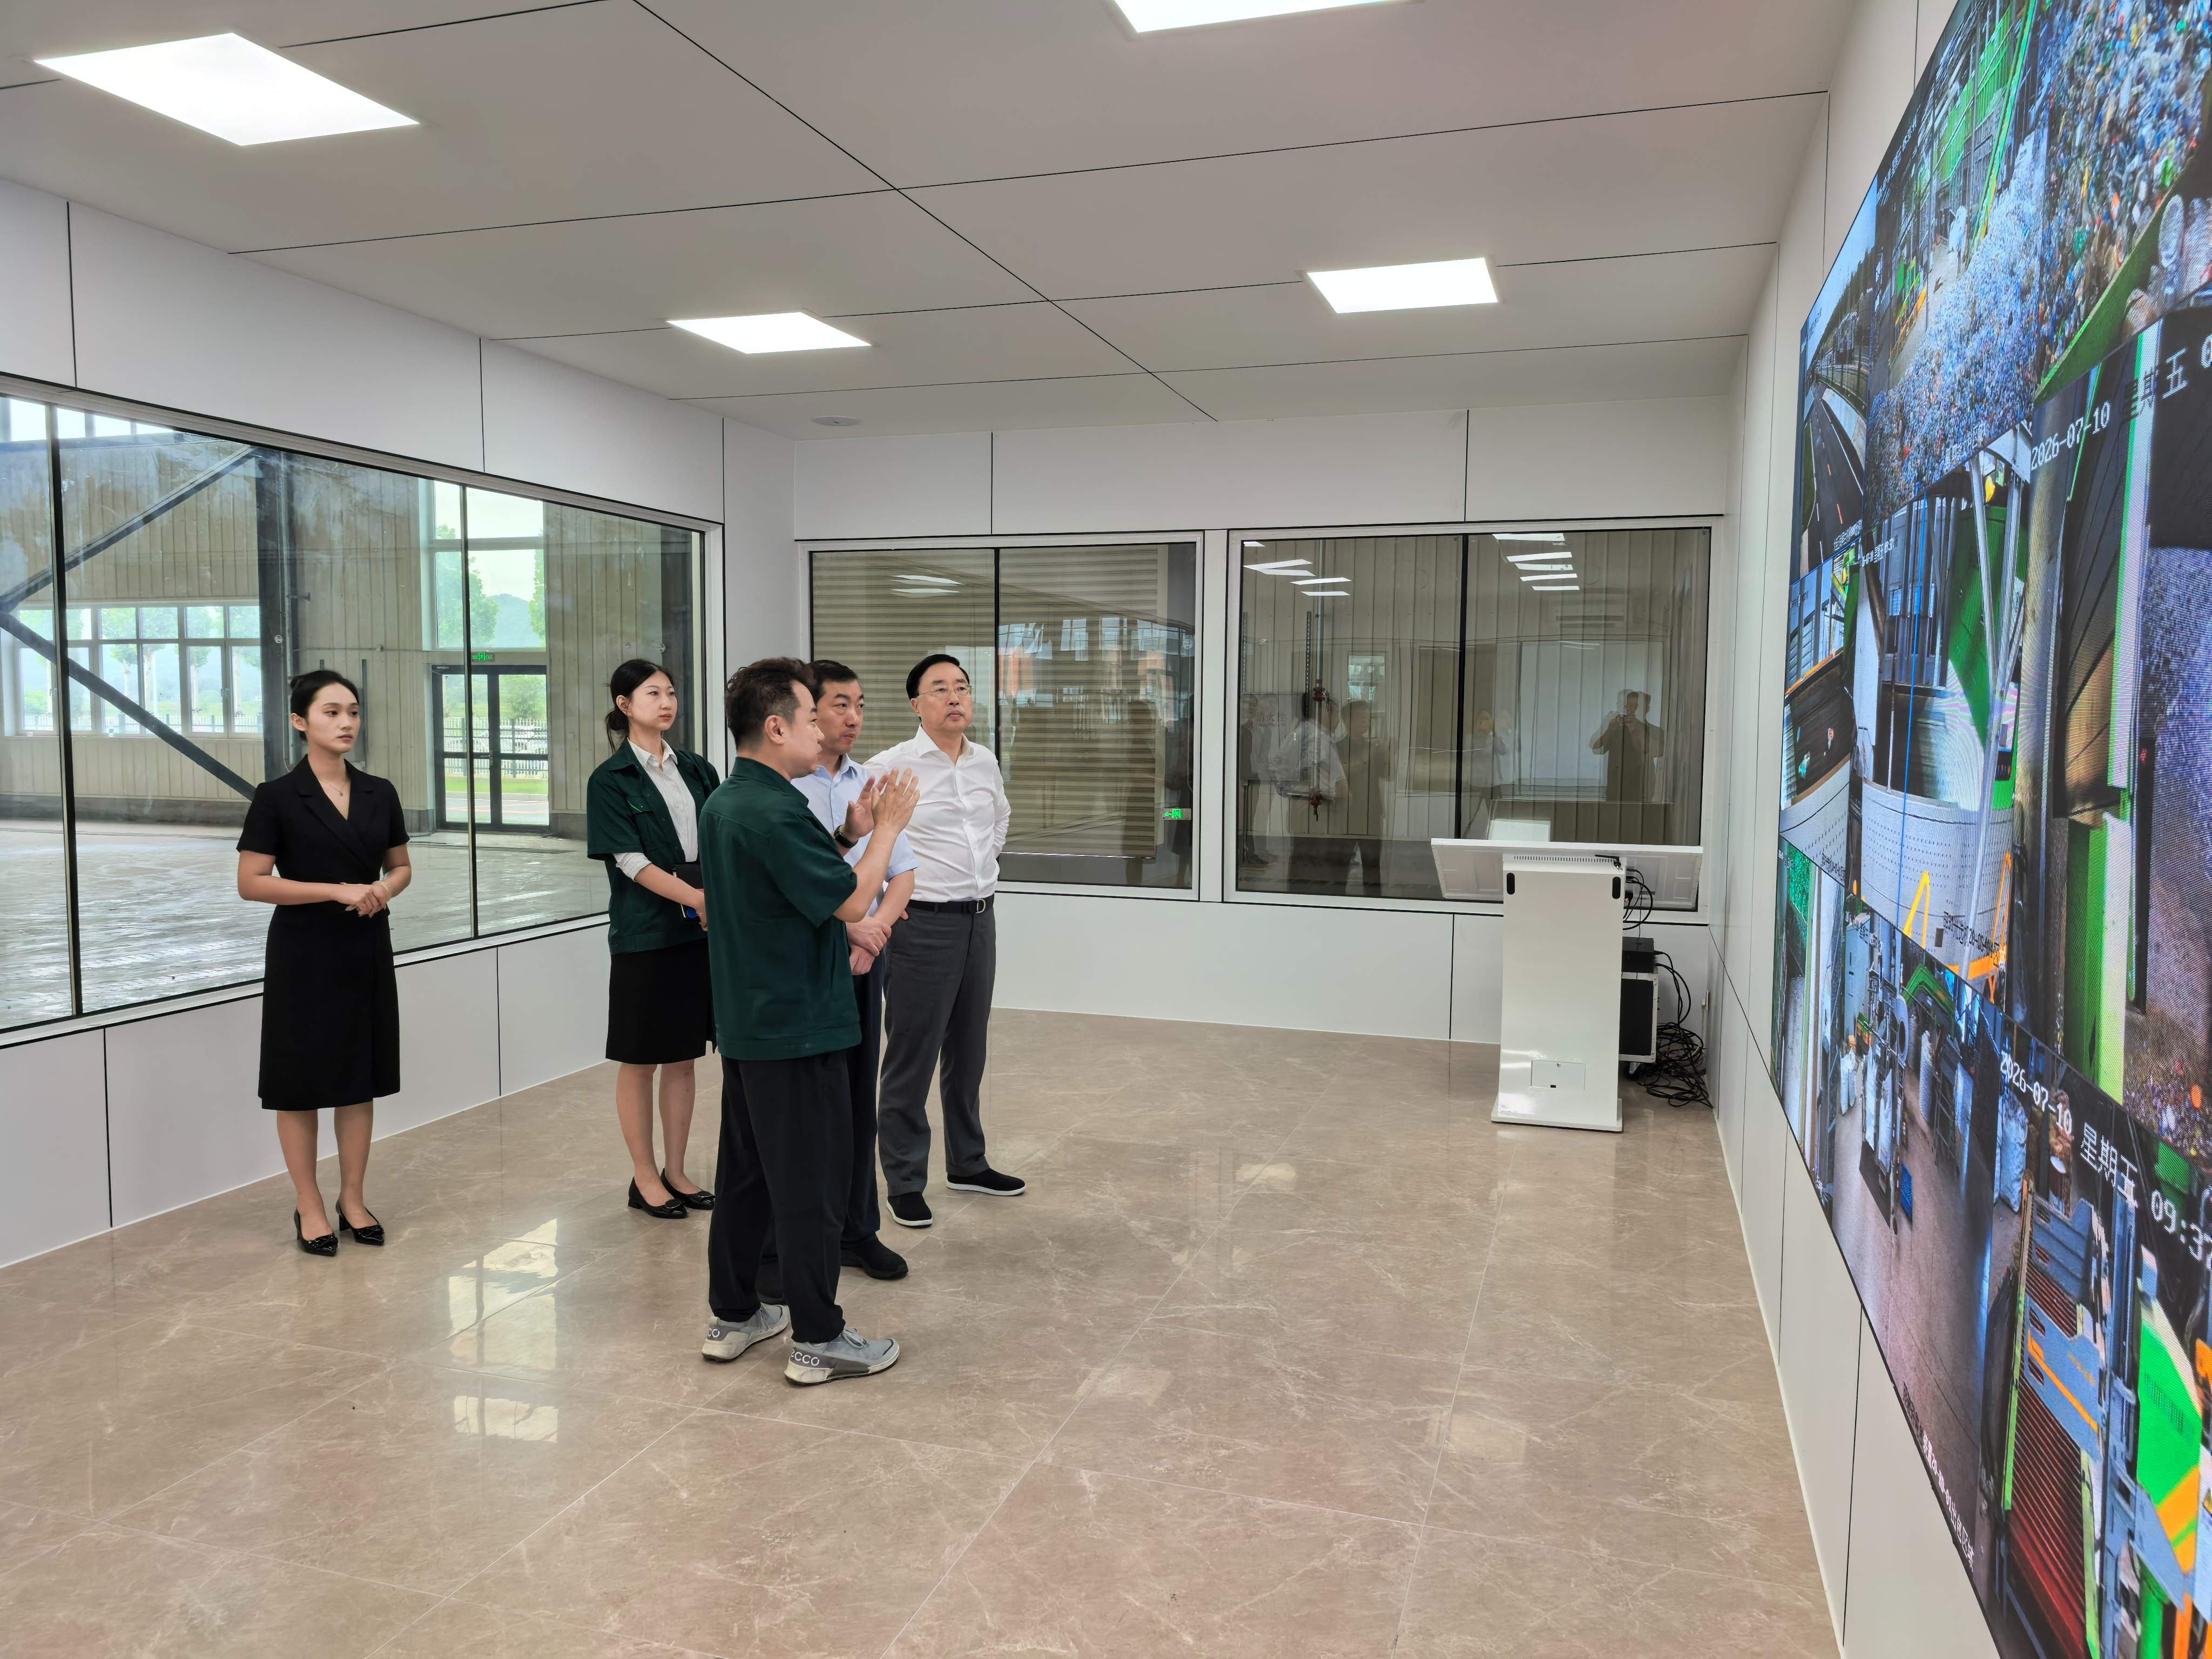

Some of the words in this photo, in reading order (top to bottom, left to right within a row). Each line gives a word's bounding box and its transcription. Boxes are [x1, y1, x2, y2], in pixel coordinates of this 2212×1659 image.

[2031, 401, 2111, 471] 2026-07-10
[2000, 1049, 2073, 1136] 2026-07-10
[2080, 1121, 2139, 1209] 星期五
